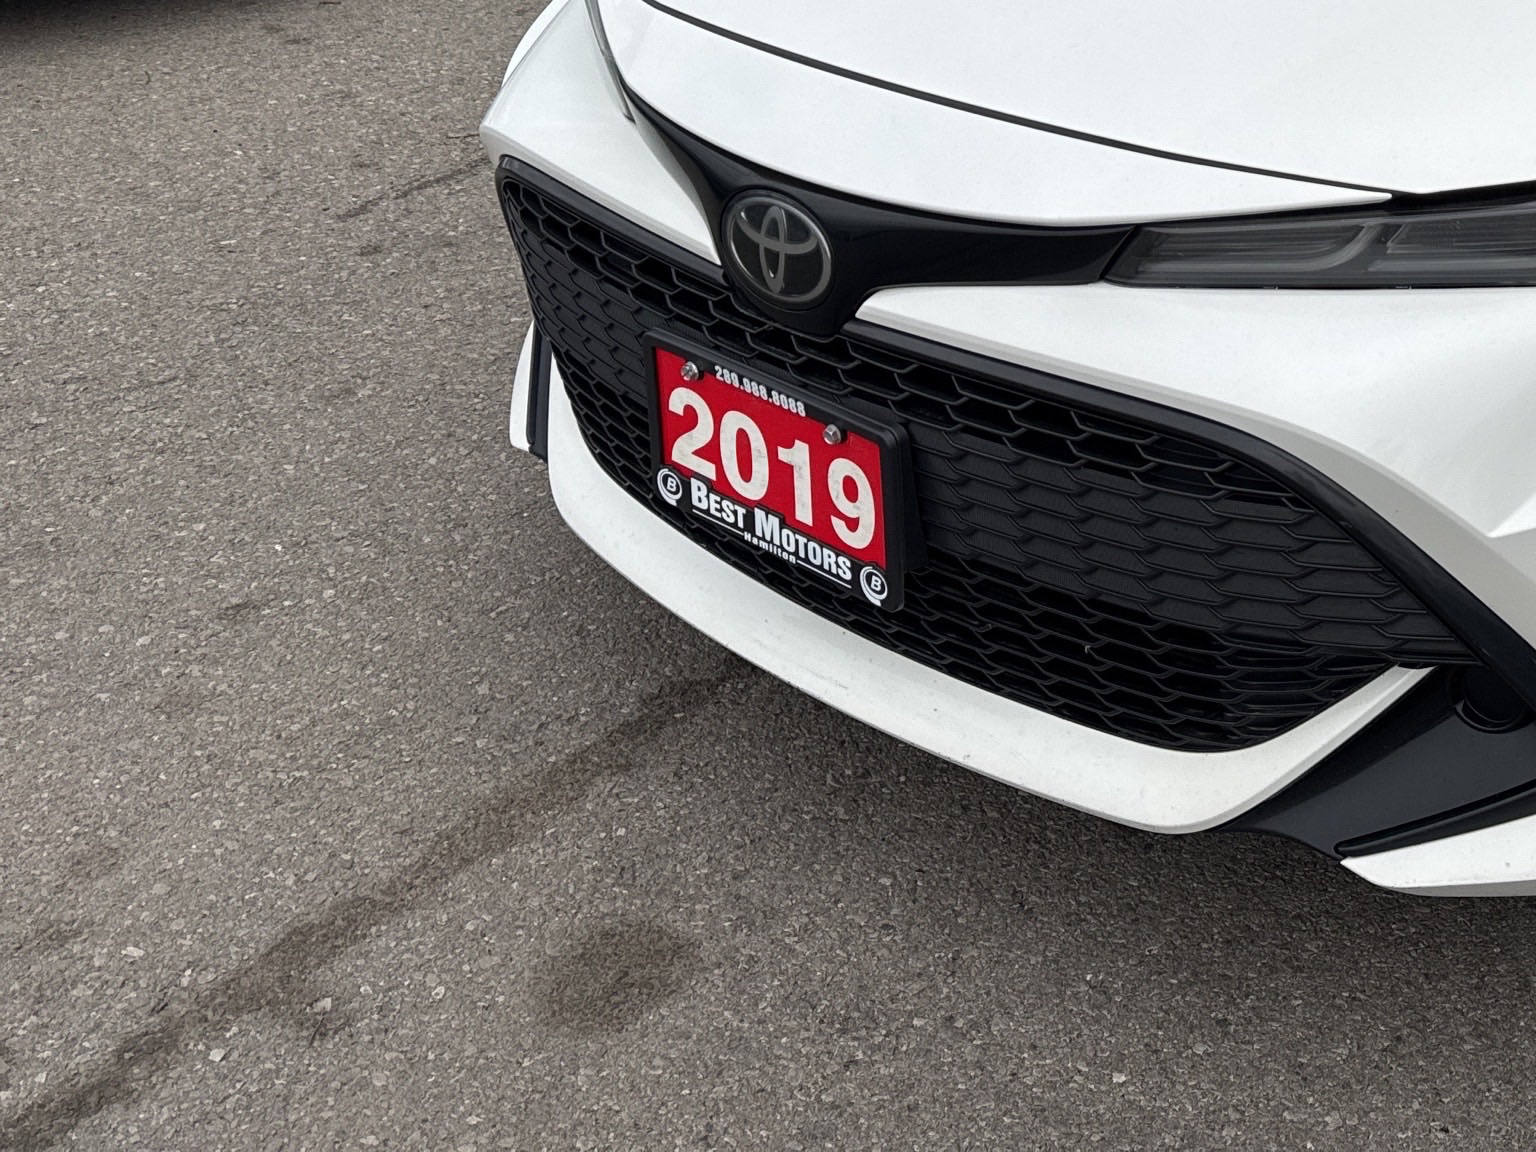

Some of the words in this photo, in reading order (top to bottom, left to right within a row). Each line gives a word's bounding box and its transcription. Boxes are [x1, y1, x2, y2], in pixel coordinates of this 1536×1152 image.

[714, 364, 806, 418] 289.988.8088
[668, 386, 876, 550] 2019
[690, 477, 747, 530] BEST
[753, 507, 853, 581] MOTORS
[743, 531, 797, 565] Hamilton
